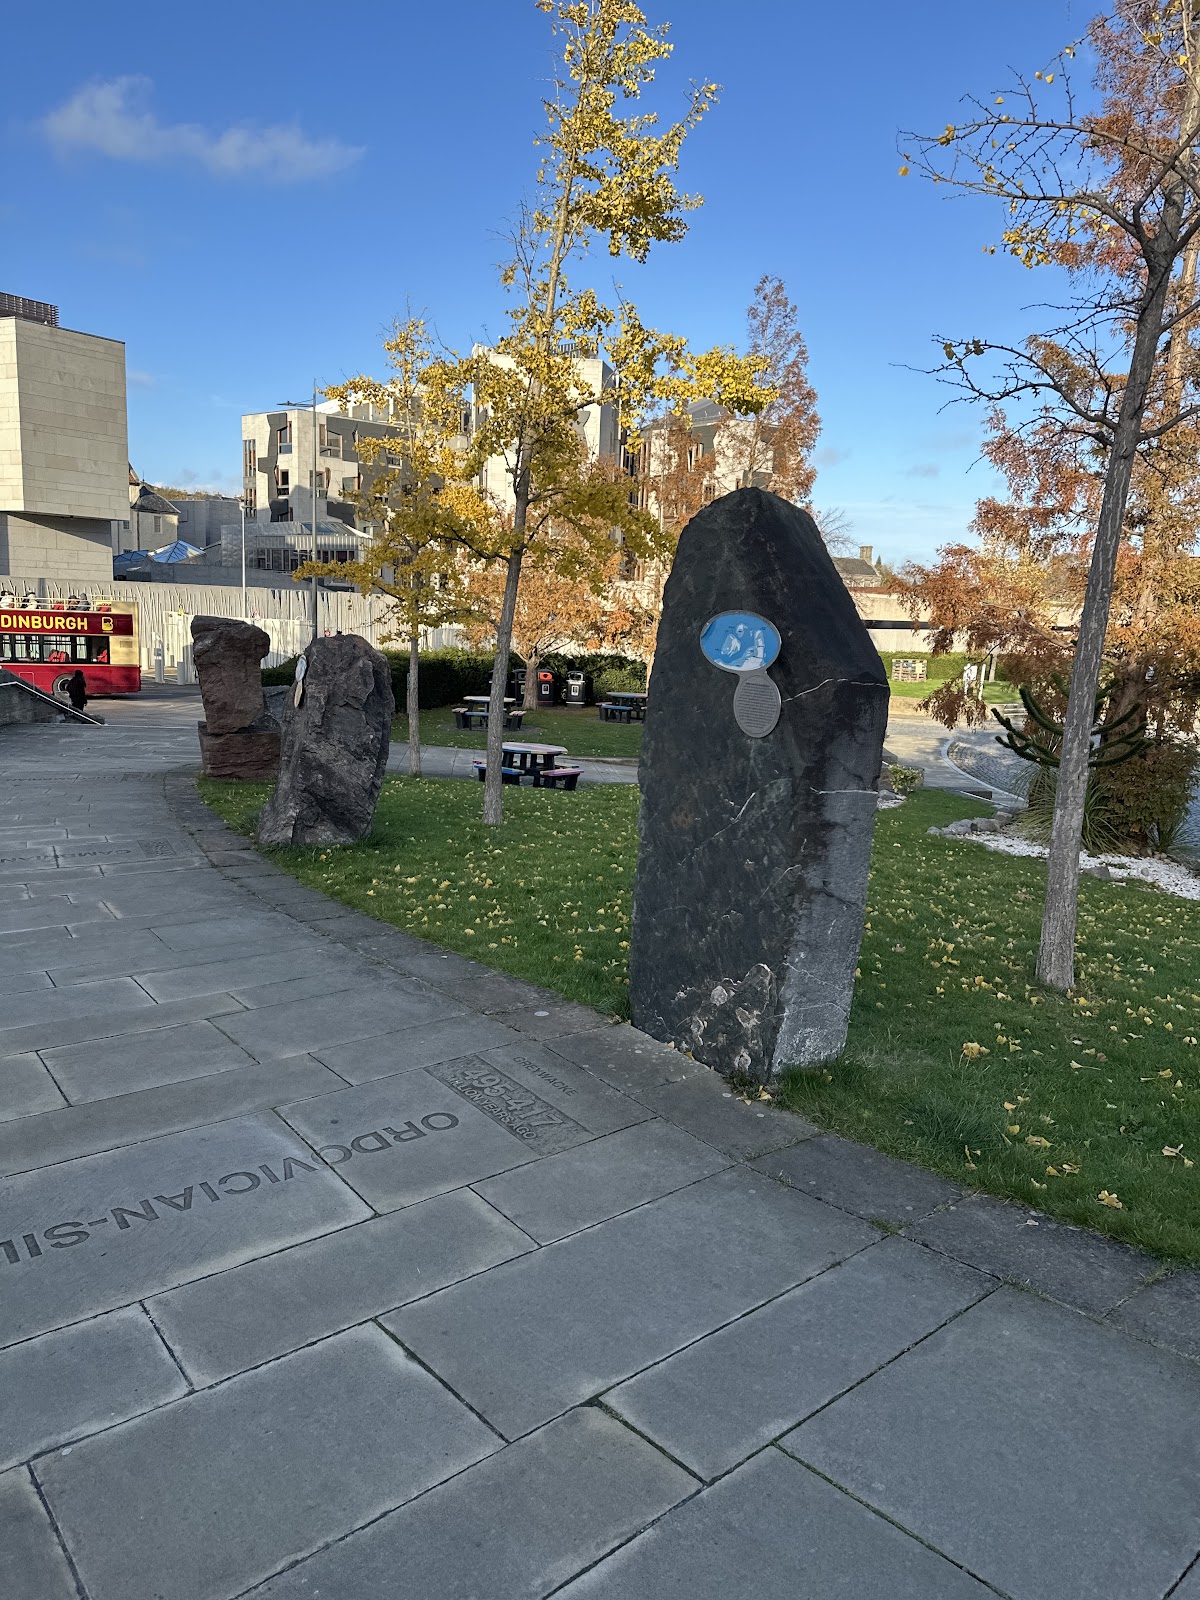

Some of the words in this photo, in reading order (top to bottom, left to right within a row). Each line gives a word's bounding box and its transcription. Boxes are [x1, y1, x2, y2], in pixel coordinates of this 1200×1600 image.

[463, 1069, 565, 1127] 495-417
[513, 1056, 579, 1097] GREYWACKE
[445, 1075, 485, 1102] MILLION
[479, 1098, 515, 1123] YEARS
[510, 1121, 537, 1140] AGO
